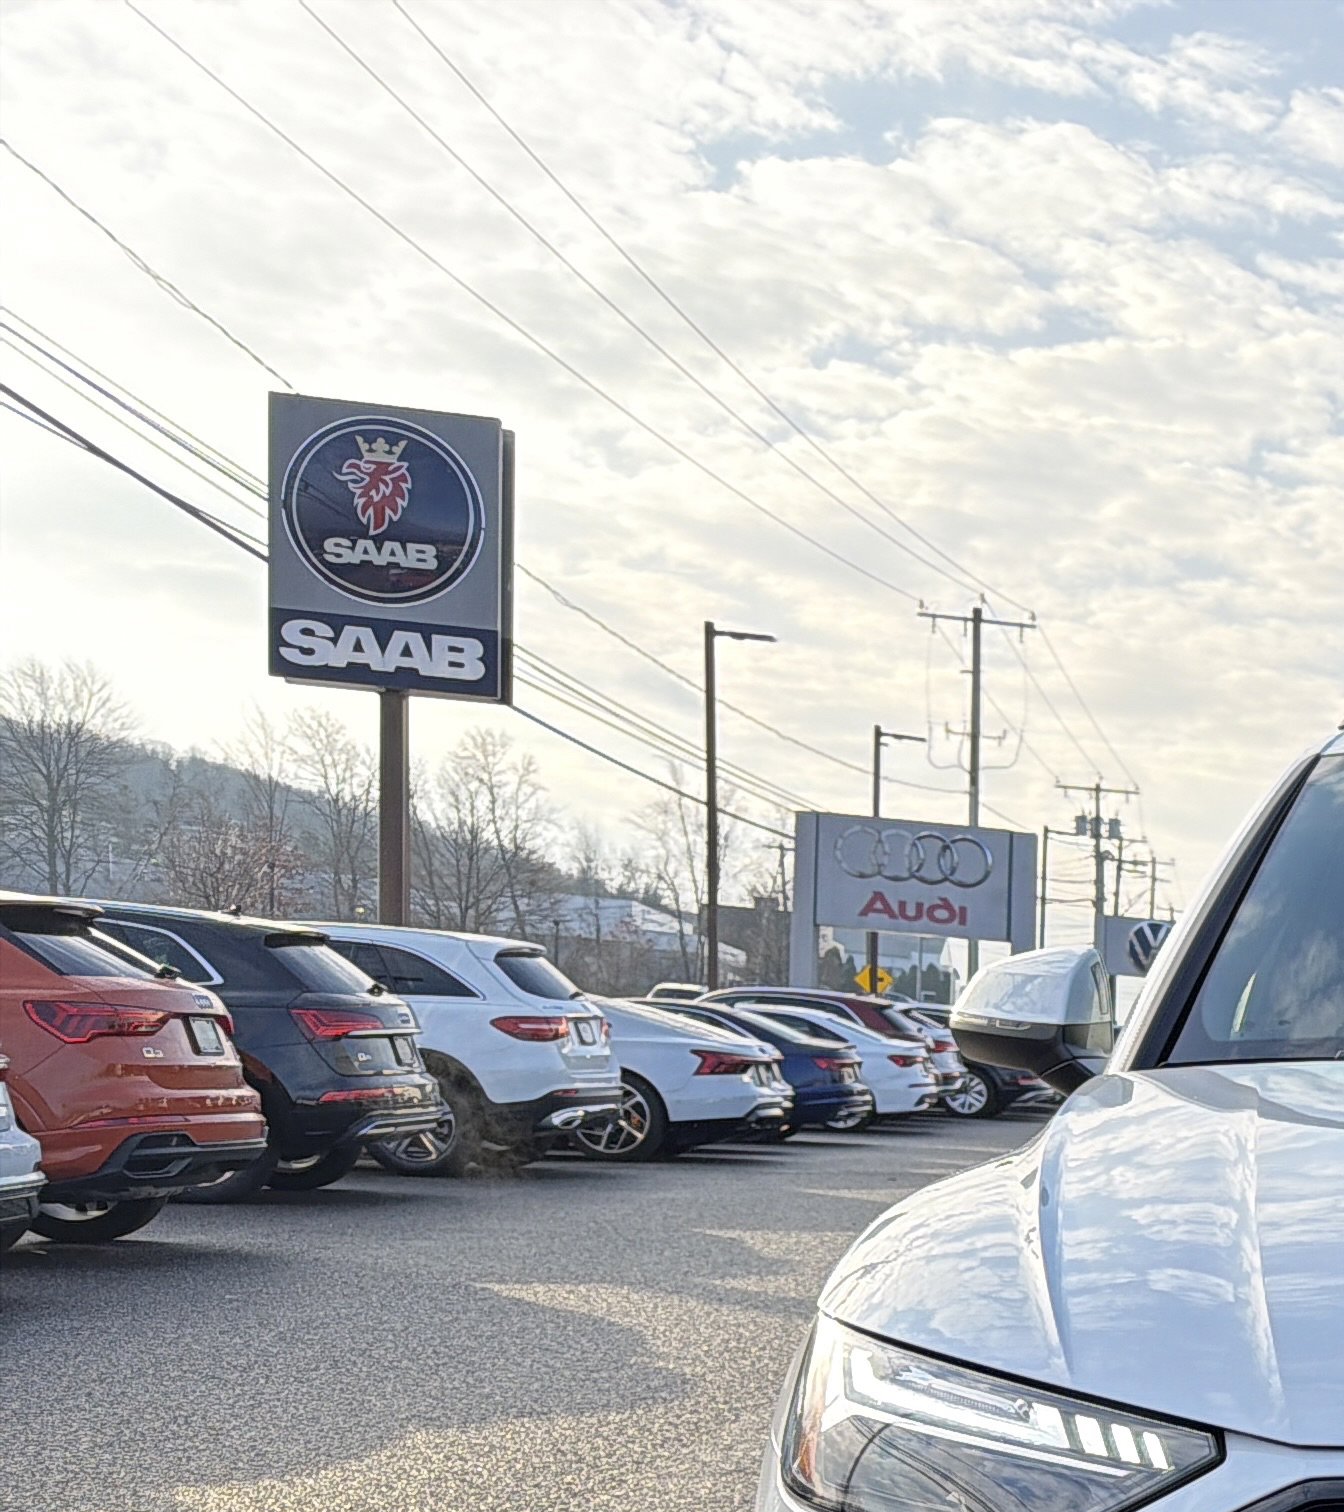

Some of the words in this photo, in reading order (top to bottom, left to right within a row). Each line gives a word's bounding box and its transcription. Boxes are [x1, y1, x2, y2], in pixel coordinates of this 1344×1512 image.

[323, 537, 438, 571] SAAB
[279, 618, 486, 681] SAAB
[857, 890, 968, 926] Audi
